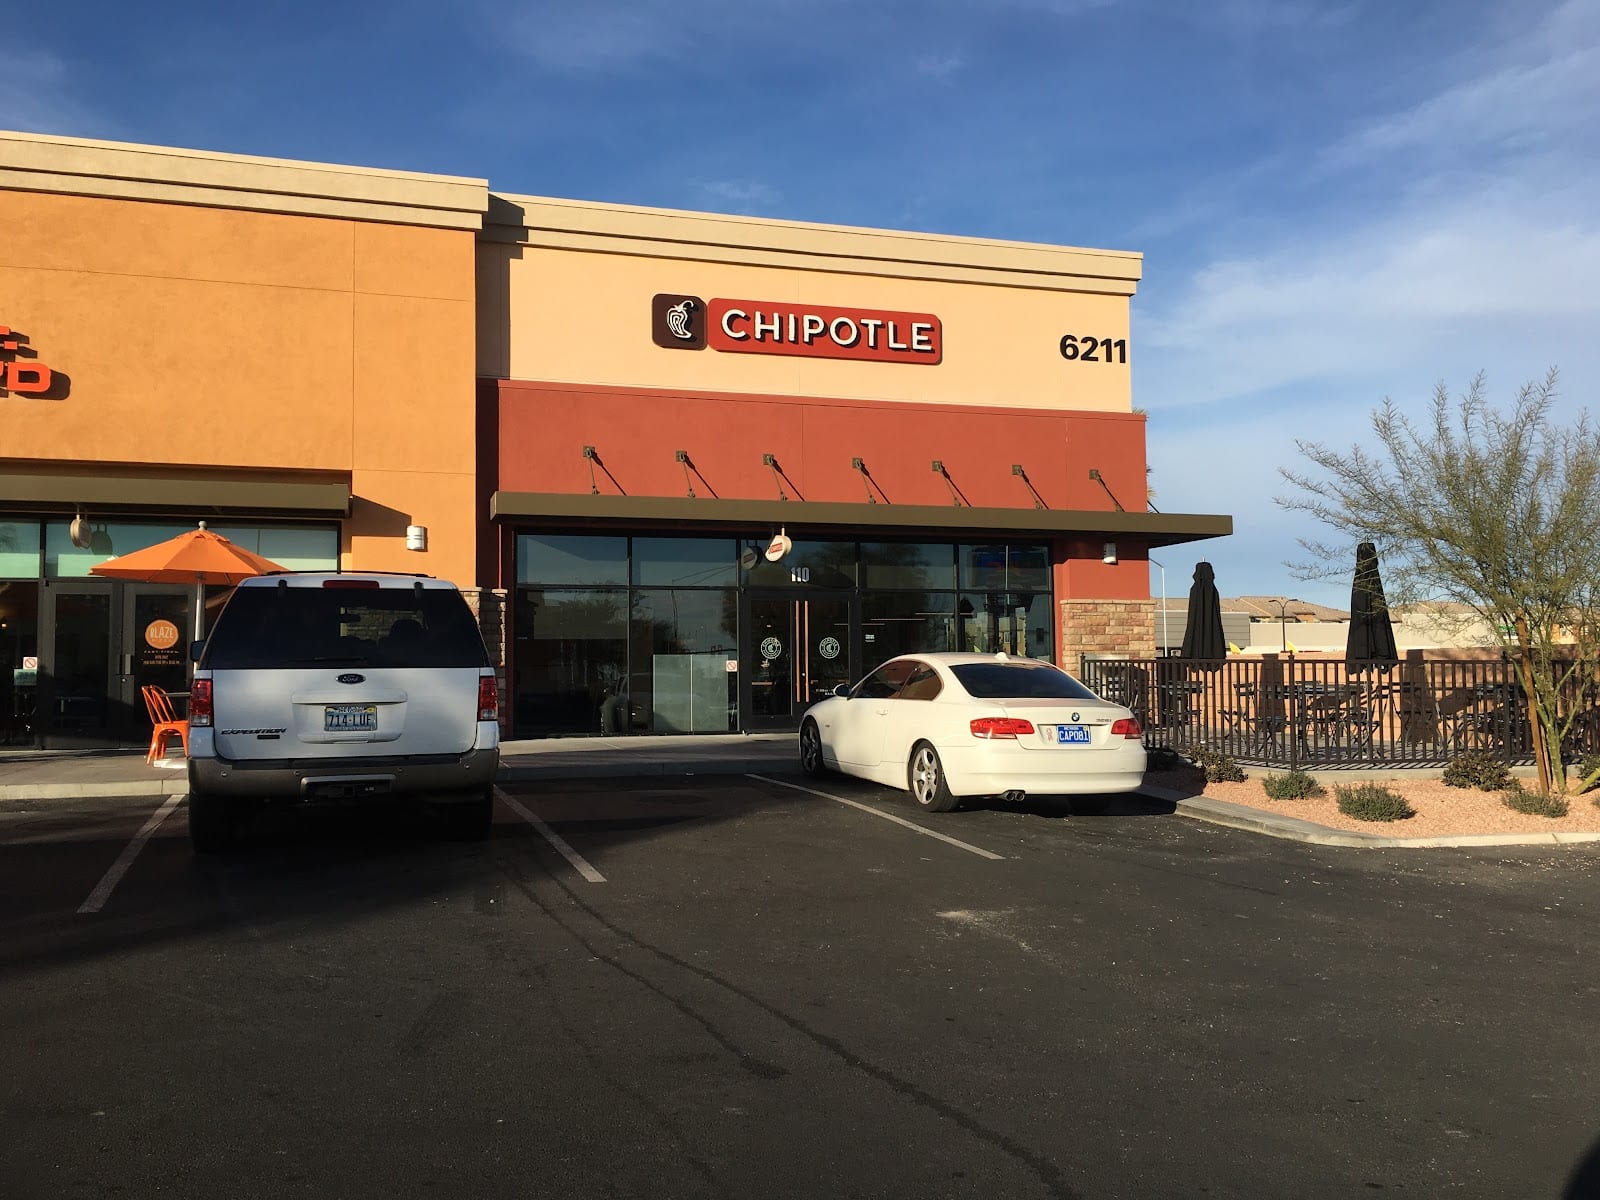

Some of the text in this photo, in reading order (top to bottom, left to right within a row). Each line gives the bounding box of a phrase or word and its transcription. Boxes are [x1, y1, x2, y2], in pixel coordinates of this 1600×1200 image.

[721, 308, 932, 351] CHIPOTLE
[1059, 334, 1126, 364] 6211
[791, 567, 809, 582] 110
[150, 626, 174, 639] BLAZE
